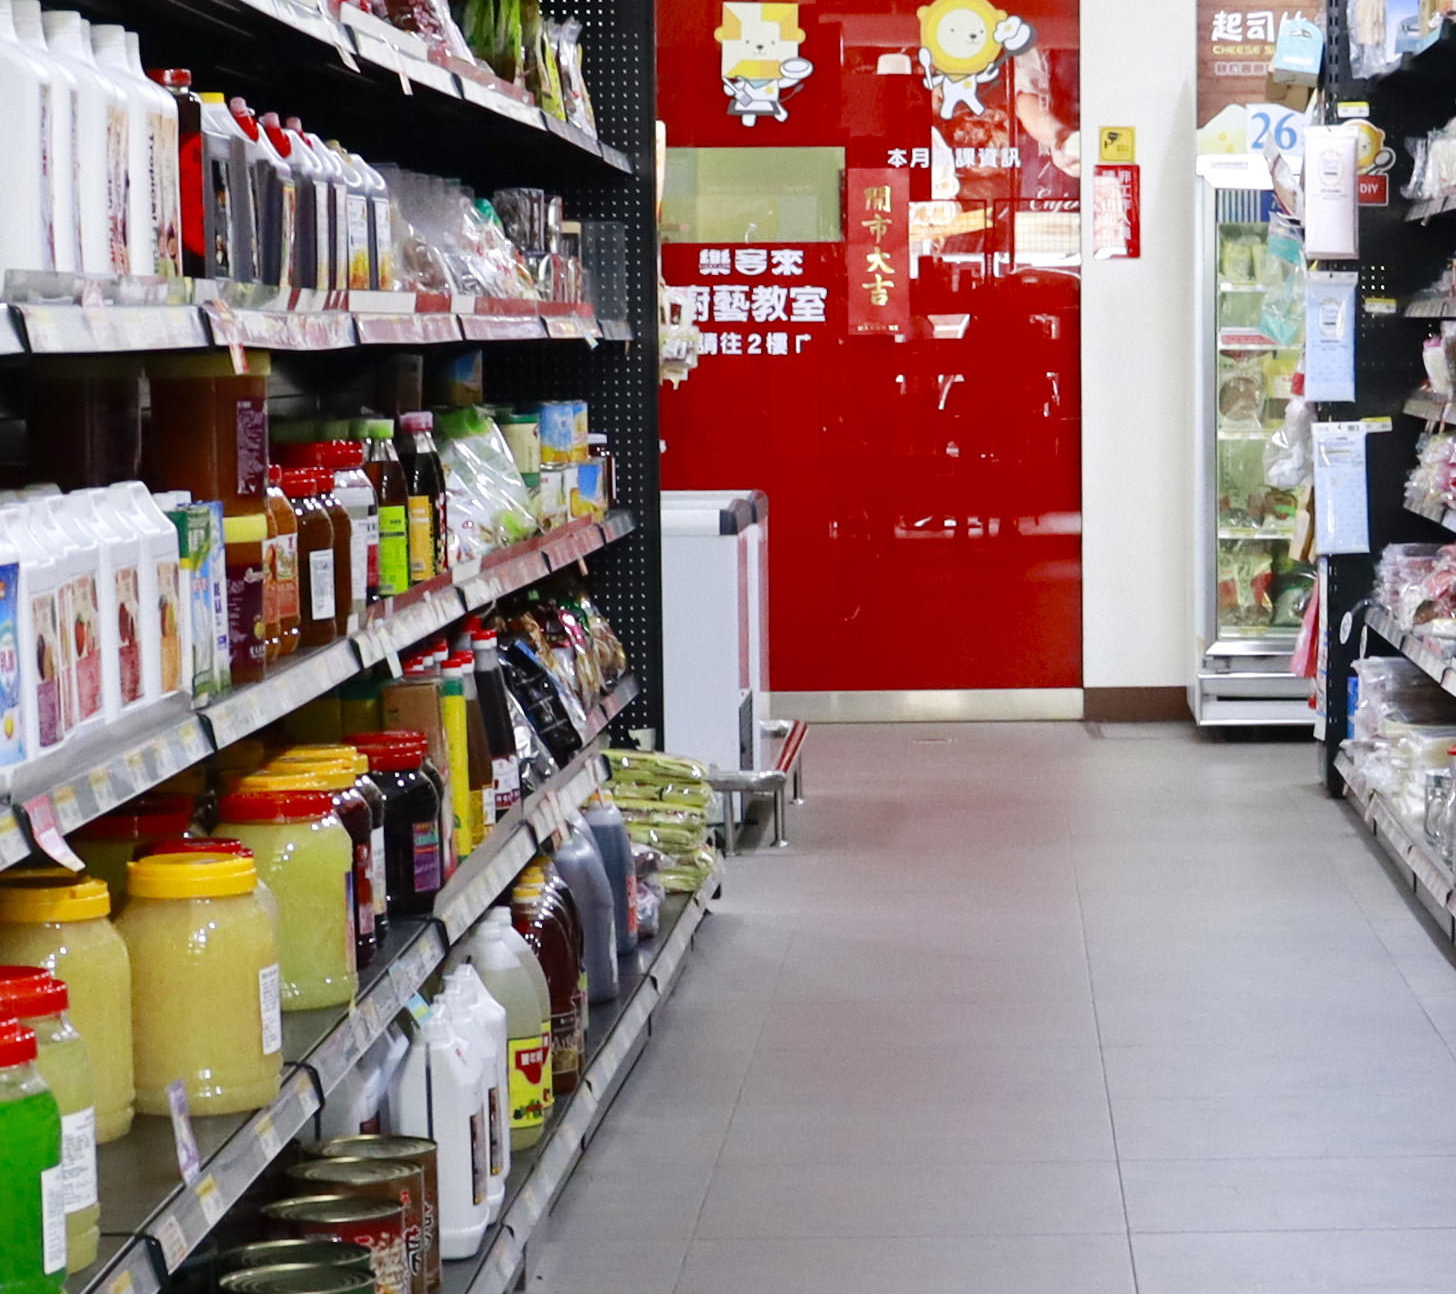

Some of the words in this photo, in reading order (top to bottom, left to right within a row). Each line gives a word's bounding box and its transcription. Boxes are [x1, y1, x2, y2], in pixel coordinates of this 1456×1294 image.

[1251, 111, 1295, 149] 26
[887, 147, 1021, 169] 本月課資訊
[1359, 183, 1378, 194] DIY
[861, 185, 895, 306] 開市大吉
